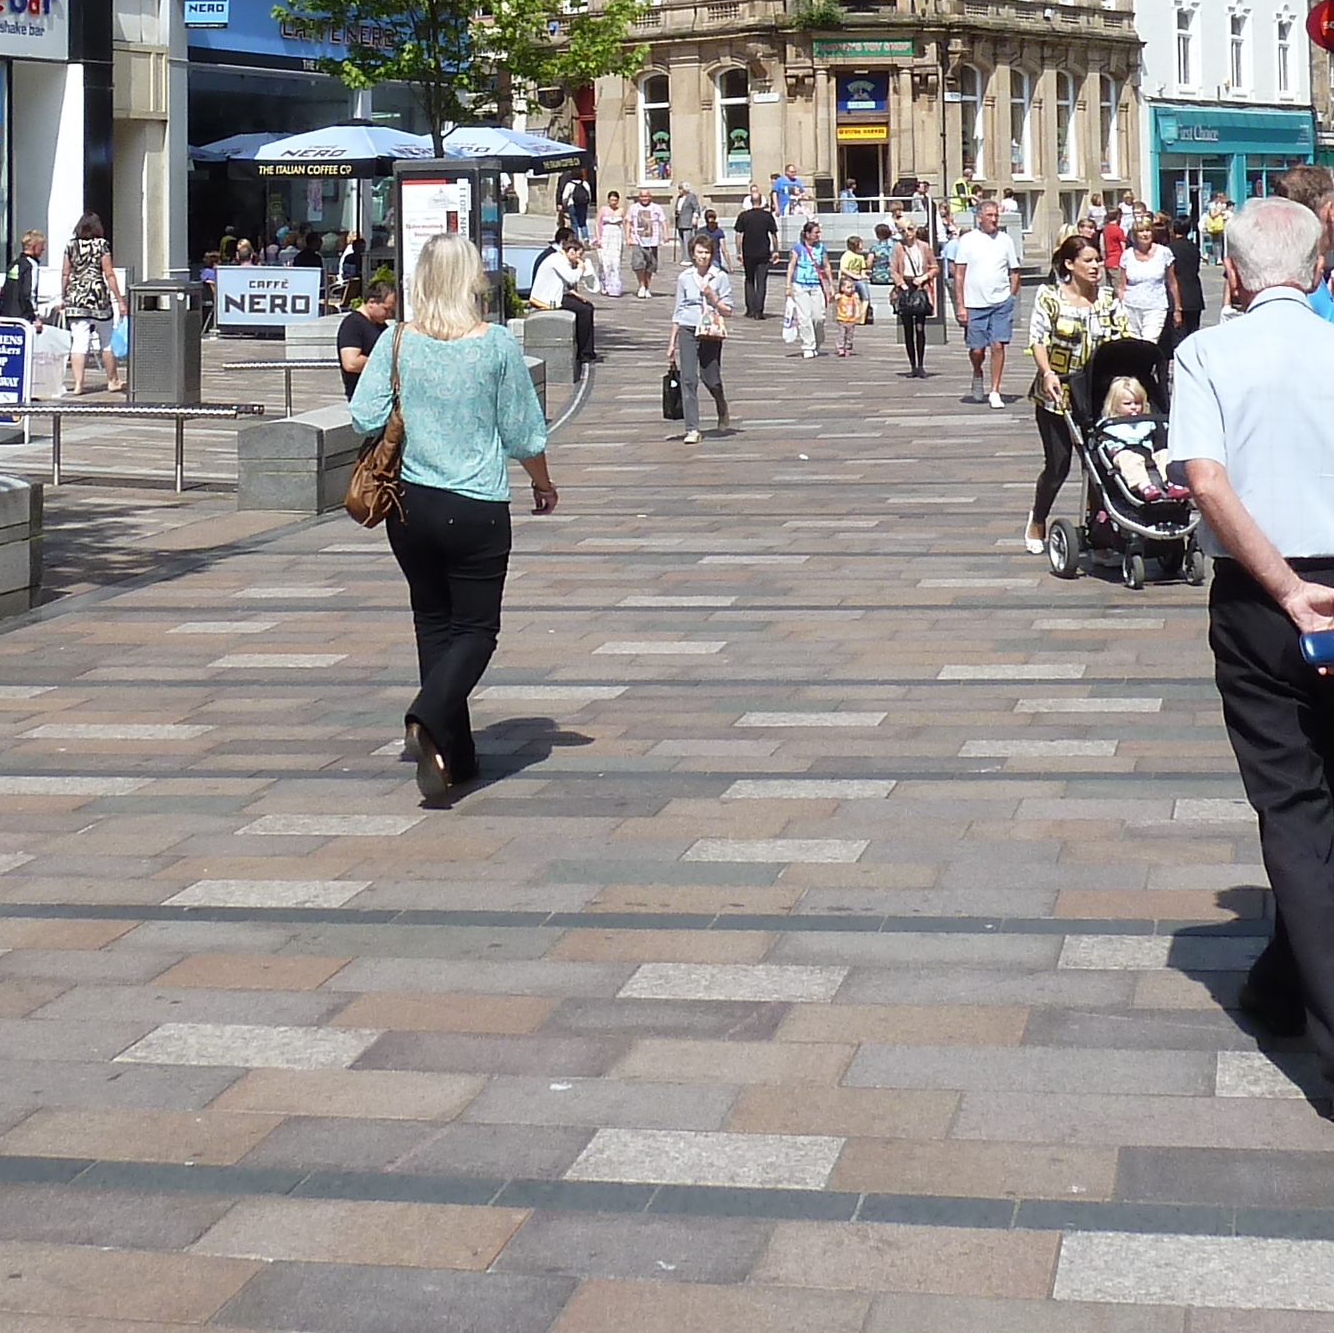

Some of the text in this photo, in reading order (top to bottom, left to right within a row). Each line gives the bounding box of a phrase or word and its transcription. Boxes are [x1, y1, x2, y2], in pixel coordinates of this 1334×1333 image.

[188, 3, 225, 13] NERO
[29, 23, 46, 37] bar
[1193, 125, 1219, 142] Choice
[258, 165, 274, 175] THE
[275, 164, 306, 175] ITALIAN
[306, 164, 340, 175] COFFEE
[248, 278, 289, 289] CAFFÈ
[224, 293, 311, 314] NERO
